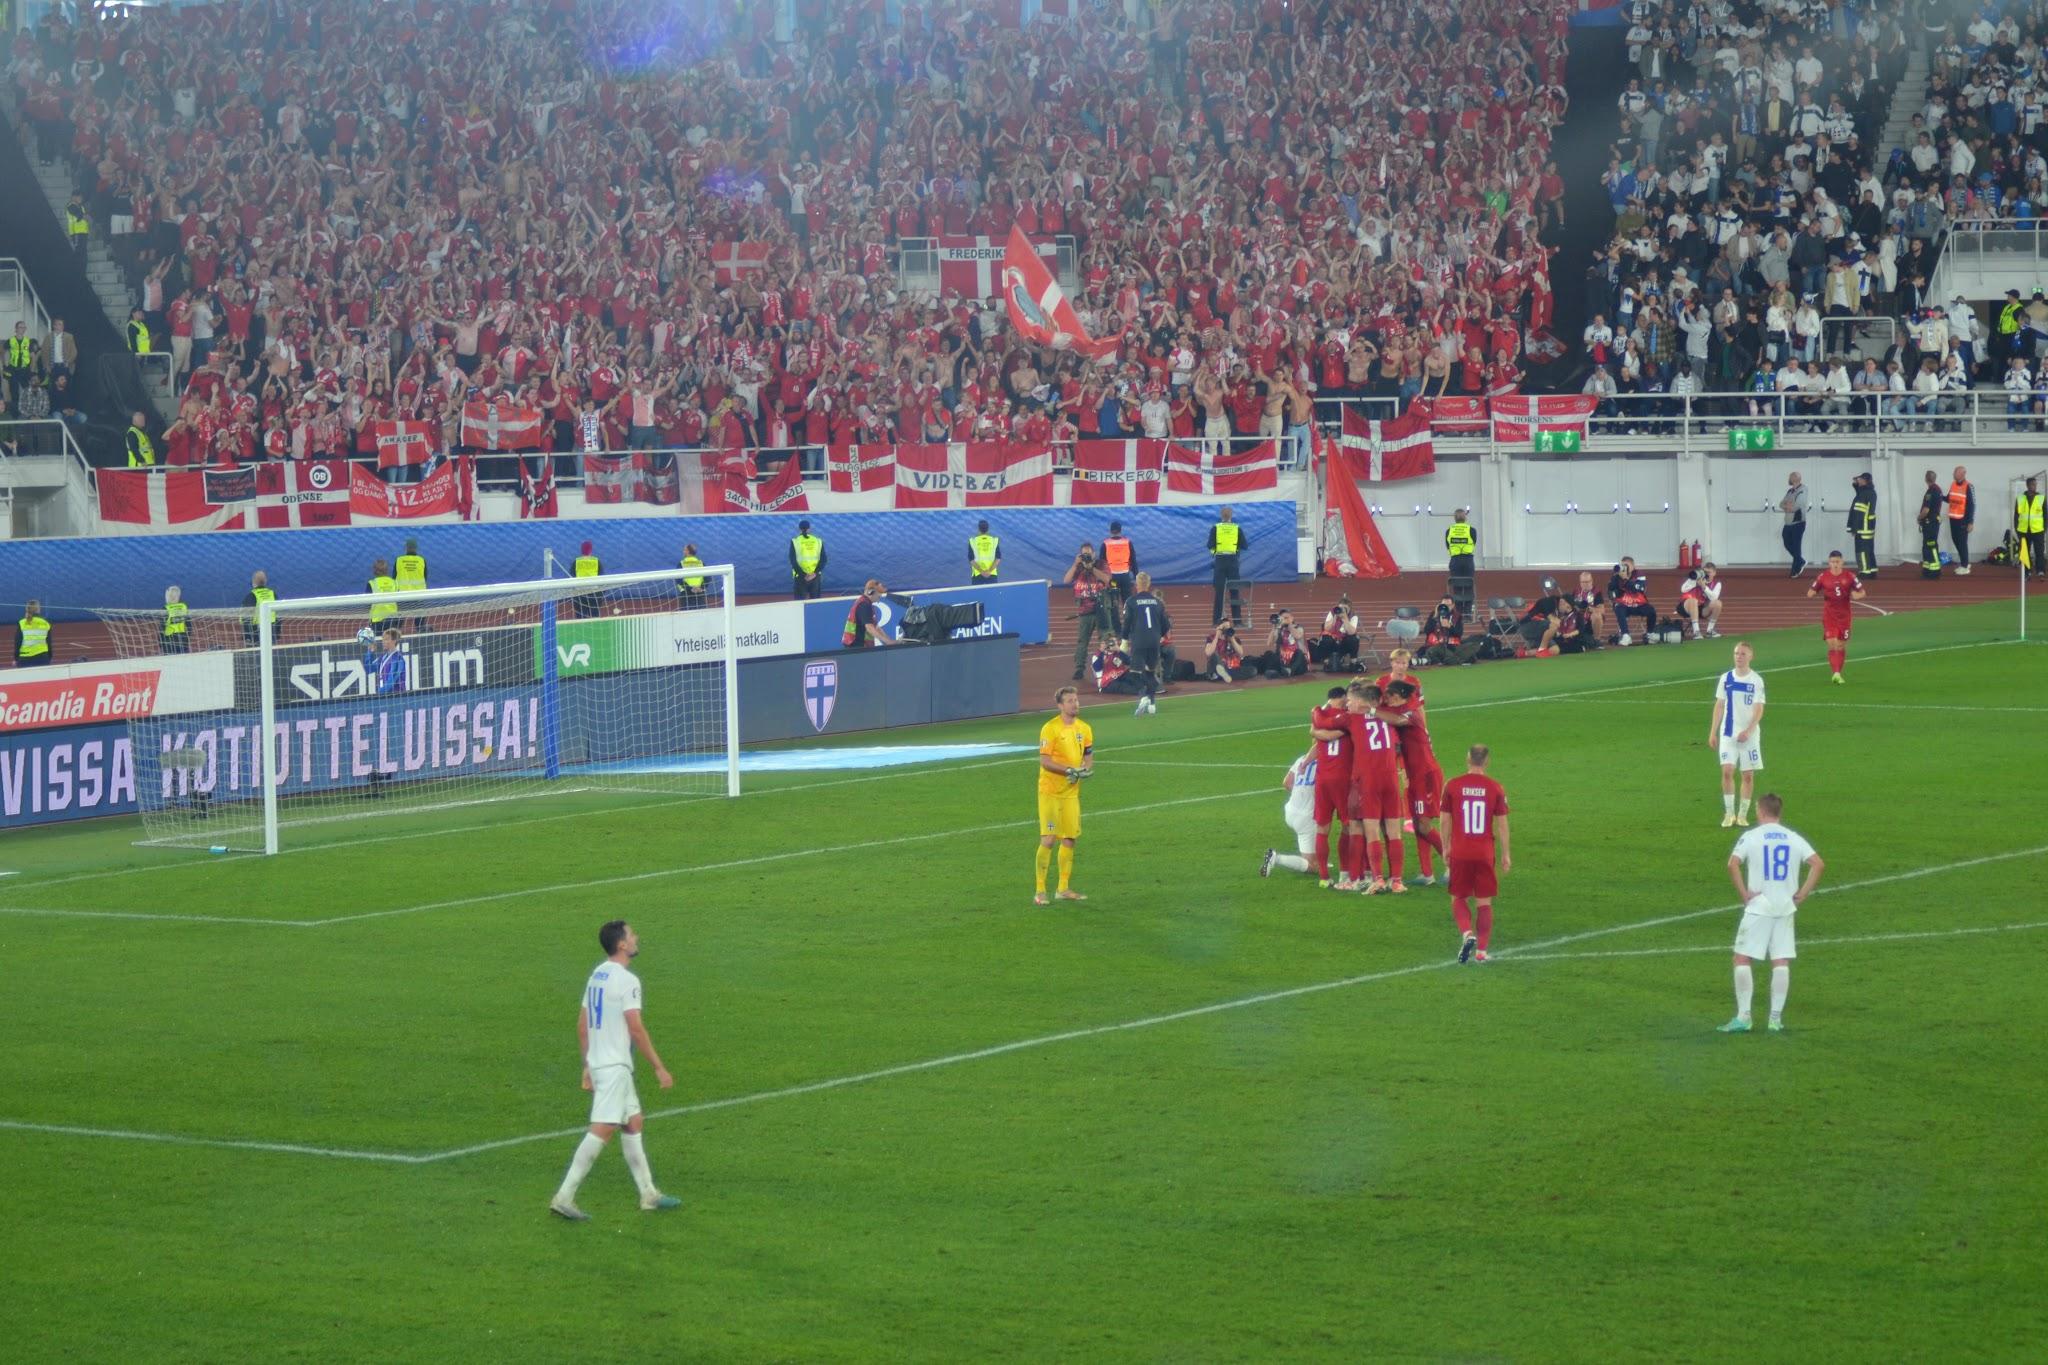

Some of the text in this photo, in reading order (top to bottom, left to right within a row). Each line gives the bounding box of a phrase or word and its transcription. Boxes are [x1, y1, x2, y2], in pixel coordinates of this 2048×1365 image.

[1514, 416, 1554, 424] HORSENS
[313, 472, 327, 483] OB
[913, 471, 1006, 491] VIDEBÆK
[281, 492, 324, 504] ODENSE
[1835, 586, 1842, 596] 5
[1145, 606, 1152, 629] 1
[556, 643, 591, 668] VR
[92, 682, 152, 718] Rent
[1743, 695, 1754, 705] 16
[1365, 721, 1391, 751] 21
[1, 698, 538, 817] VISSA KOTIOTTELUISSA!
[1748, 749, 1759, 761] 16
[1462, 800, 1486, 834] 10
[1763, 845, 1790, 881] 18
[588, 986, 604, 1029] 14
